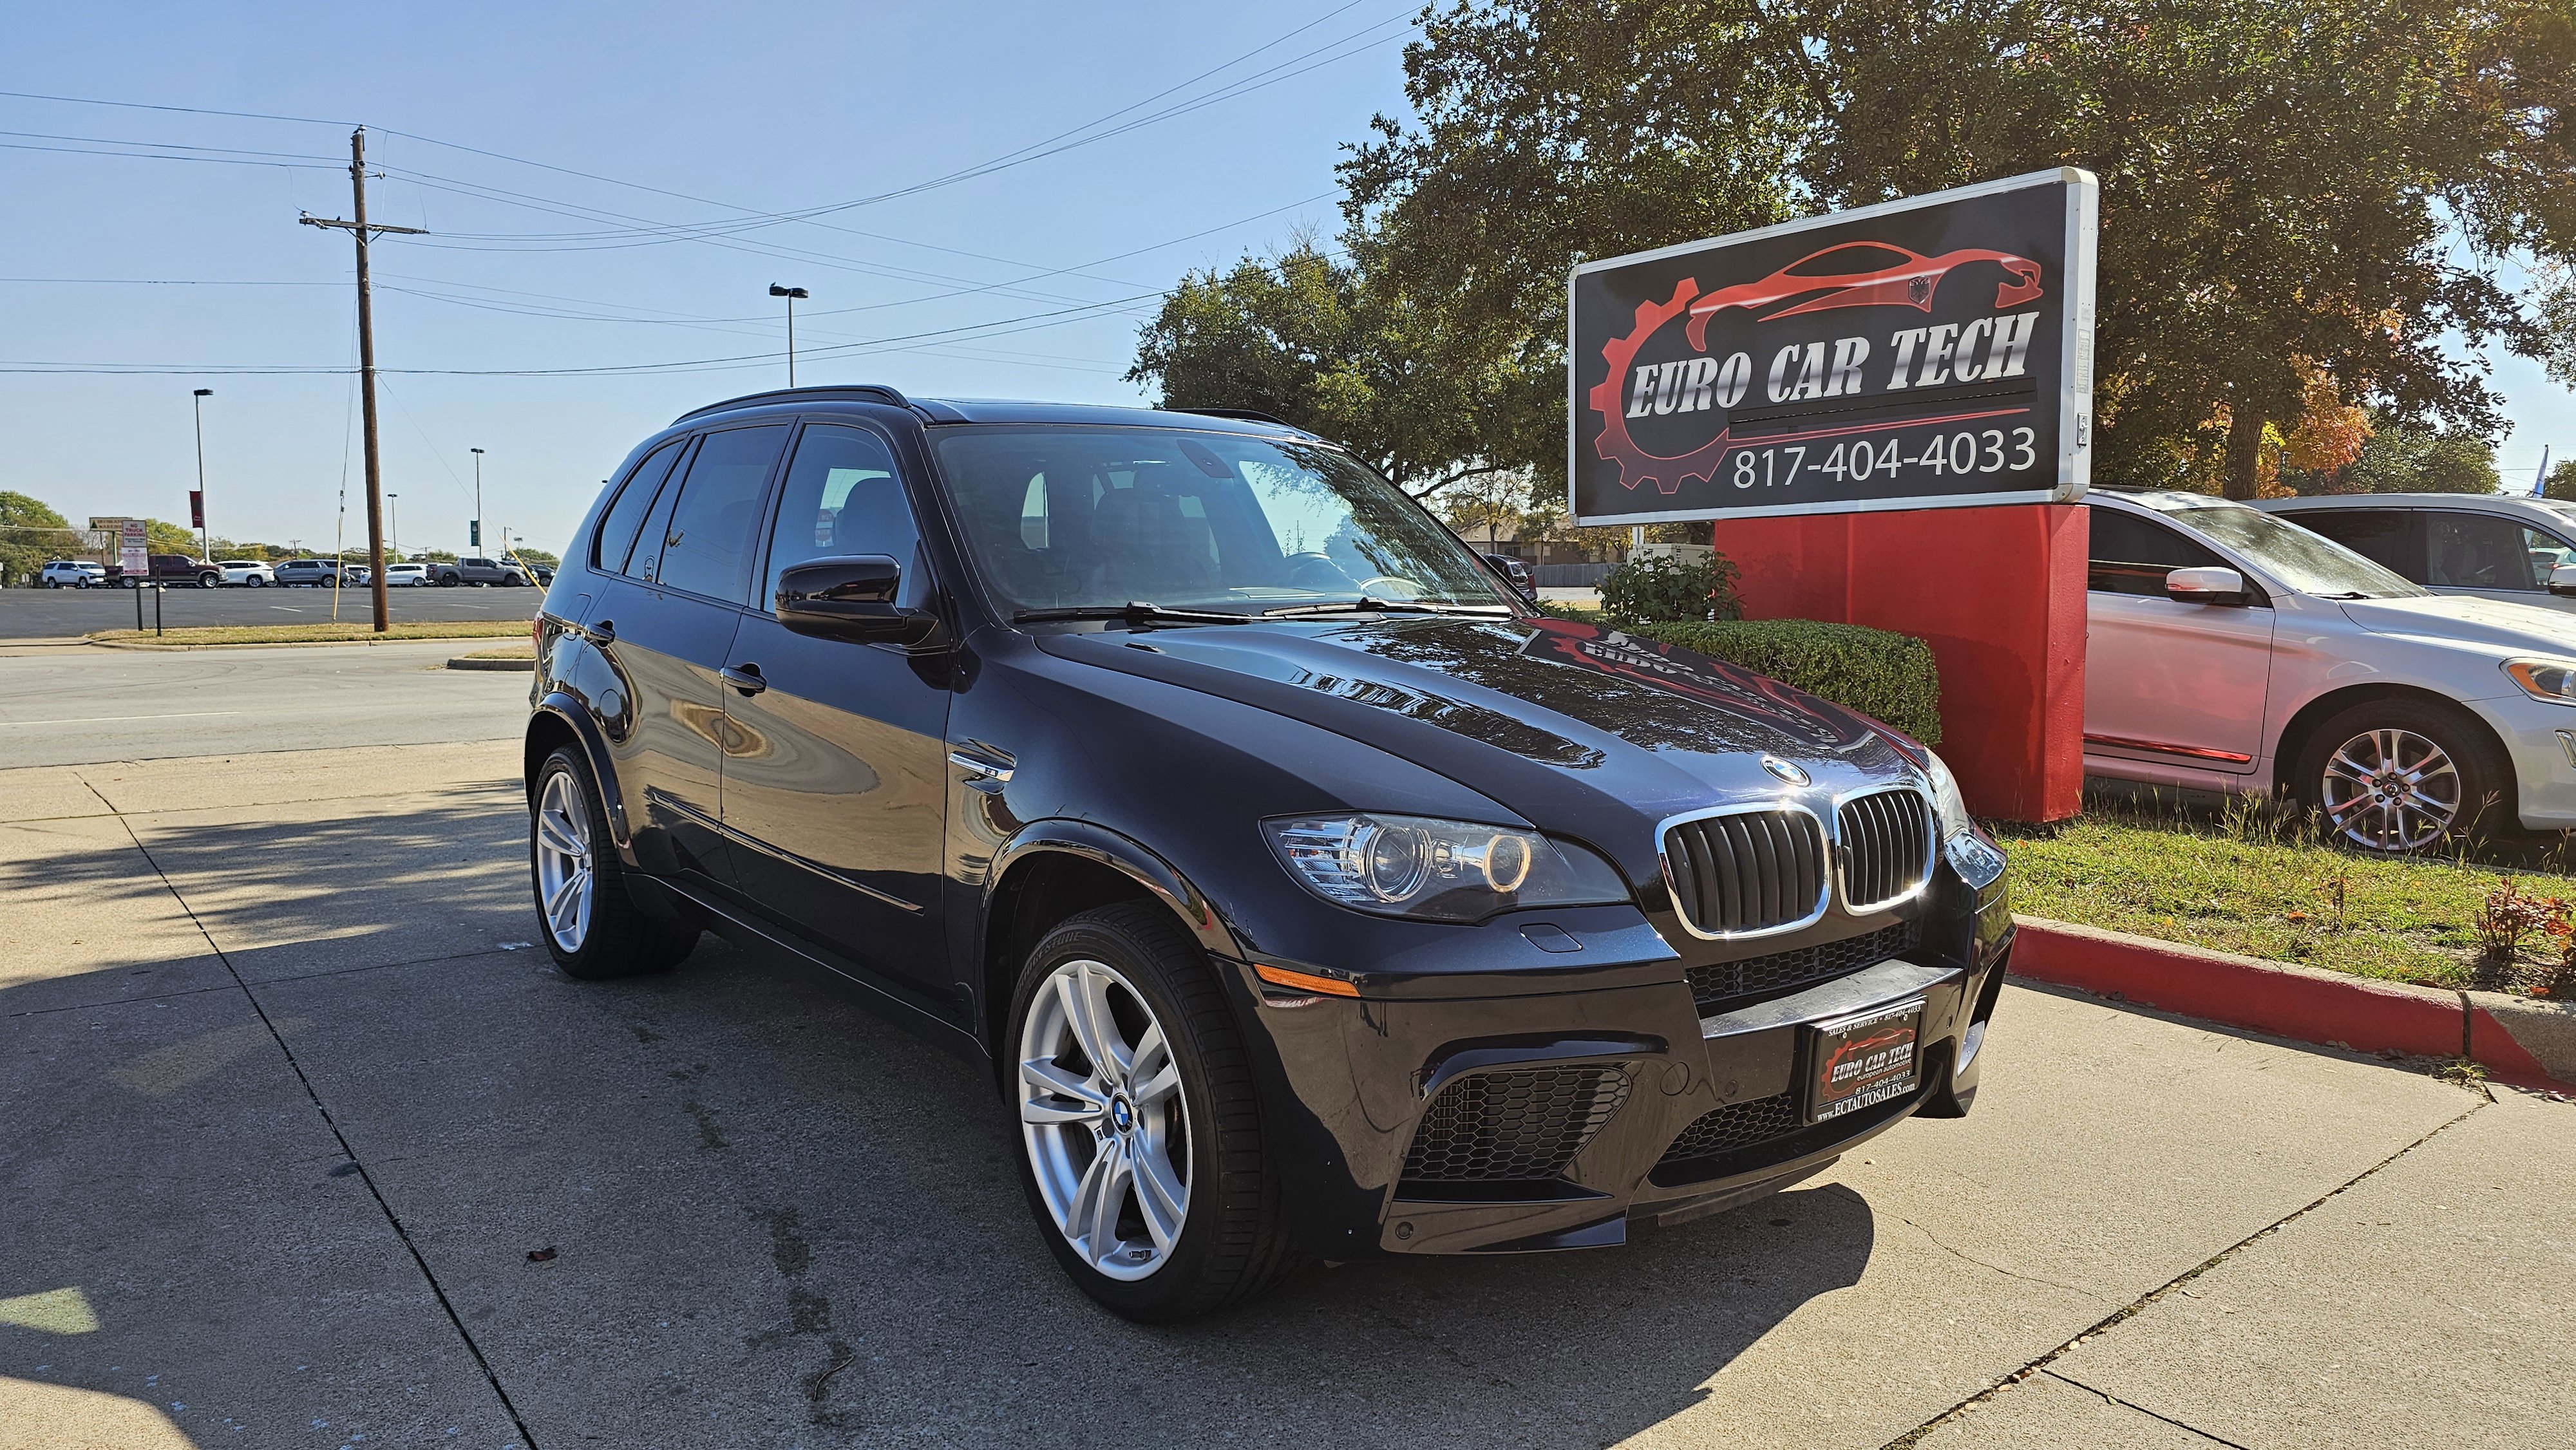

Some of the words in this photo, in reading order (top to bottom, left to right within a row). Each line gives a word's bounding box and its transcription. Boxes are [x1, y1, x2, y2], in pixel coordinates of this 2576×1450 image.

[1626, 351, 1752, 419] EURO
[1767, 335, 1871, 404] CAR
[1886, 311, 2040, 391] TECH
[1733, 426, 2036, 489] 817-404-4033
[1828, 1026, 1846, 1037] SALES
[1846, 1023, 1852, 1031] &
[1853, 1017, 1879, 1030] SERVICE
[1831, 1059, 1863, 1083] EURO
[1865, 1051, 1886, 1072] CAR
[1889, 1041, 1915, 1063] TECH
[1855, 1069, 1910, 1095] 817-404-4033
[1857, 1068, 1882, 1082] european
[1883, 1057, 1912, 1074] automotive
[1817, 1081, 1915, 1122] www.ECTAUTOSALES.com
